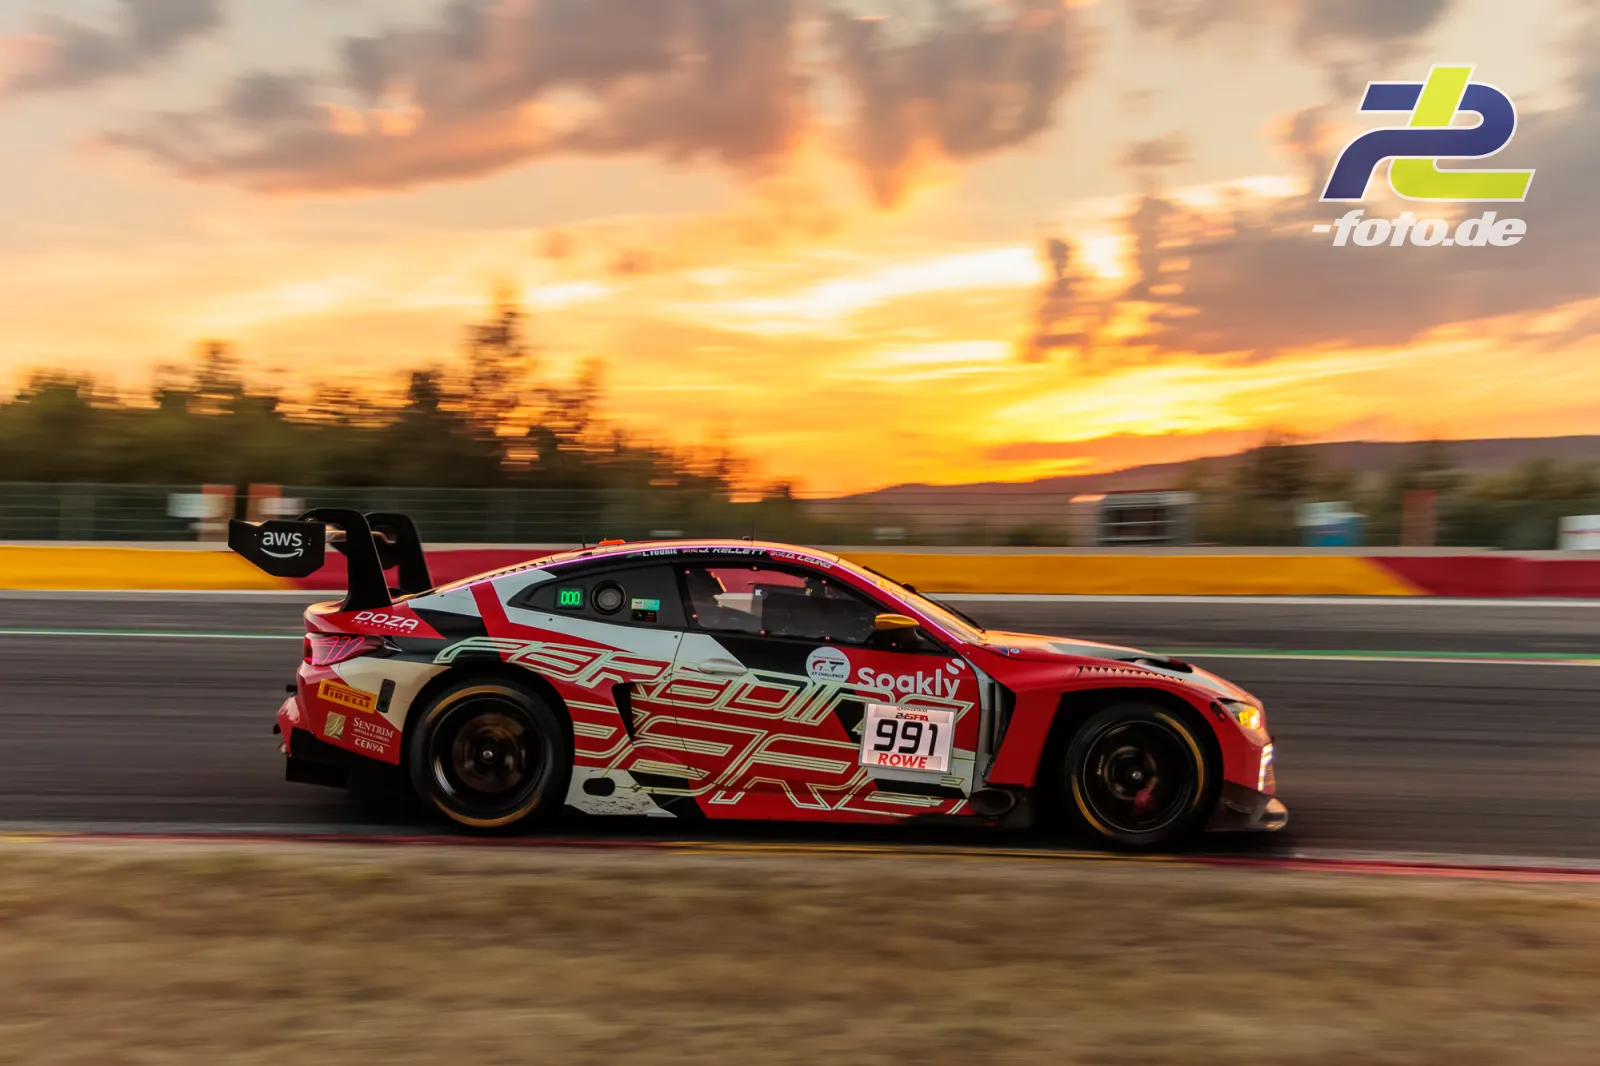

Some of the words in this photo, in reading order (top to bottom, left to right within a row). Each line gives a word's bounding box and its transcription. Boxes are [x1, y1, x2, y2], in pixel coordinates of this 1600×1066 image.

[262, 531, 302, 547] aws
[354, 611, 419, 631] DOZA
[857, 666, 961, 700] Soakly
[322, 683, 372, 709] PIRELLI
[353, 717, 394, 739] SENTRIM
[873, 718, 939, 757] 991
[355, 738, 384, 754] KENYA
[877, 752, 928, 769] ROWE
